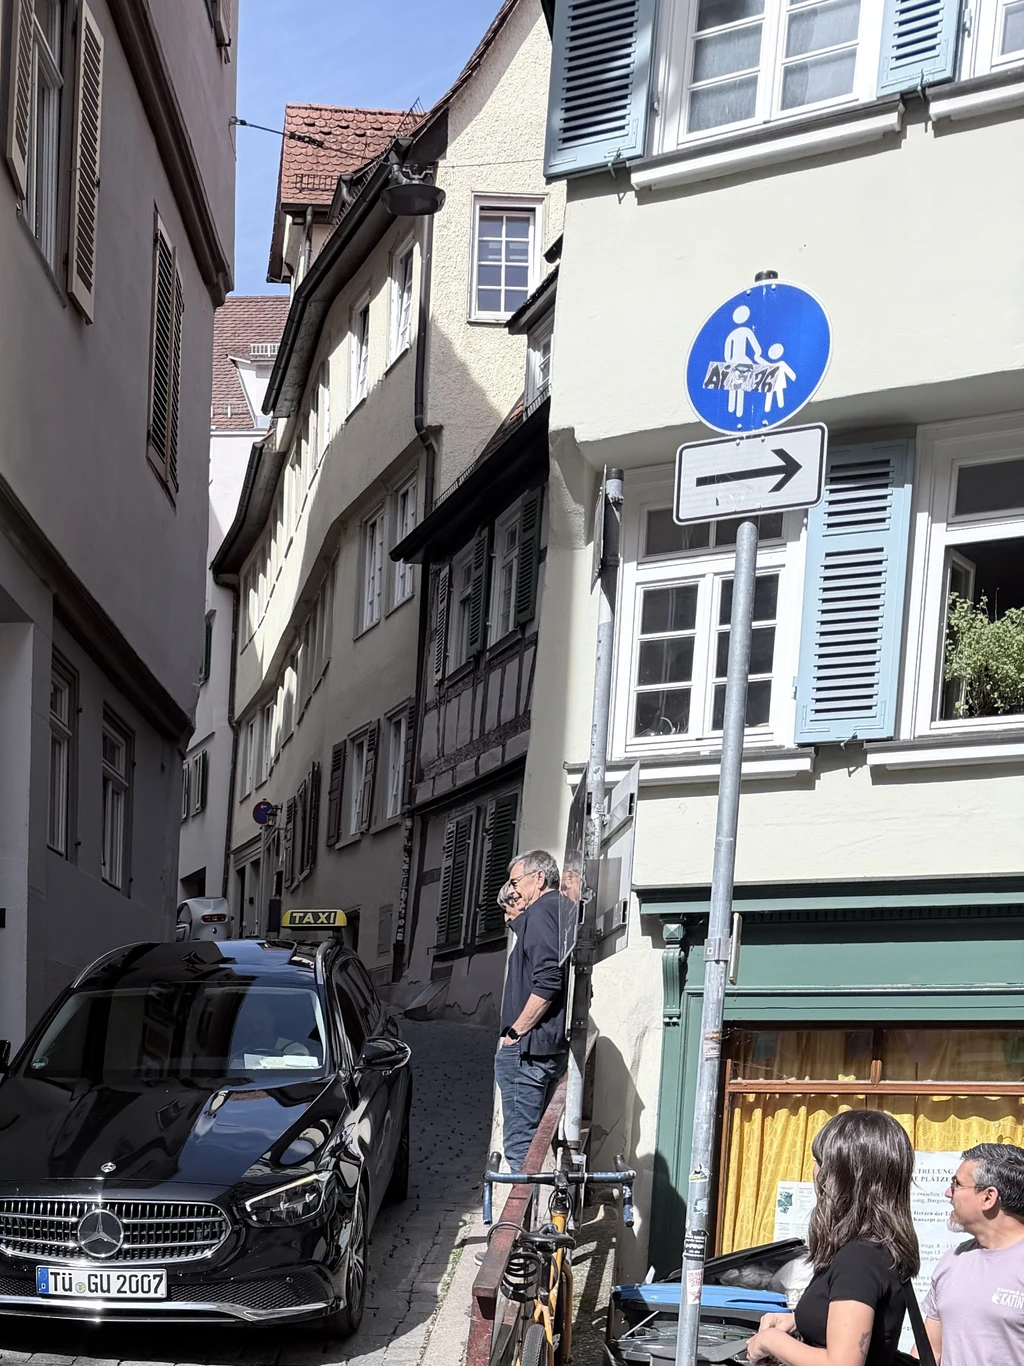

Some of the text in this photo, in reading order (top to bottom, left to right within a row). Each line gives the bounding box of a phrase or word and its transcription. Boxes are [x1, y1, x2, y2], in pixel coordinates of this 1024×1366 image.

[292, 912, 335, 924] TAXI
[50, 1271, 73, 1292] TÜ
[87, 1273, 111, 1294] GU
[116, 1273, 164, 1294] 2007
